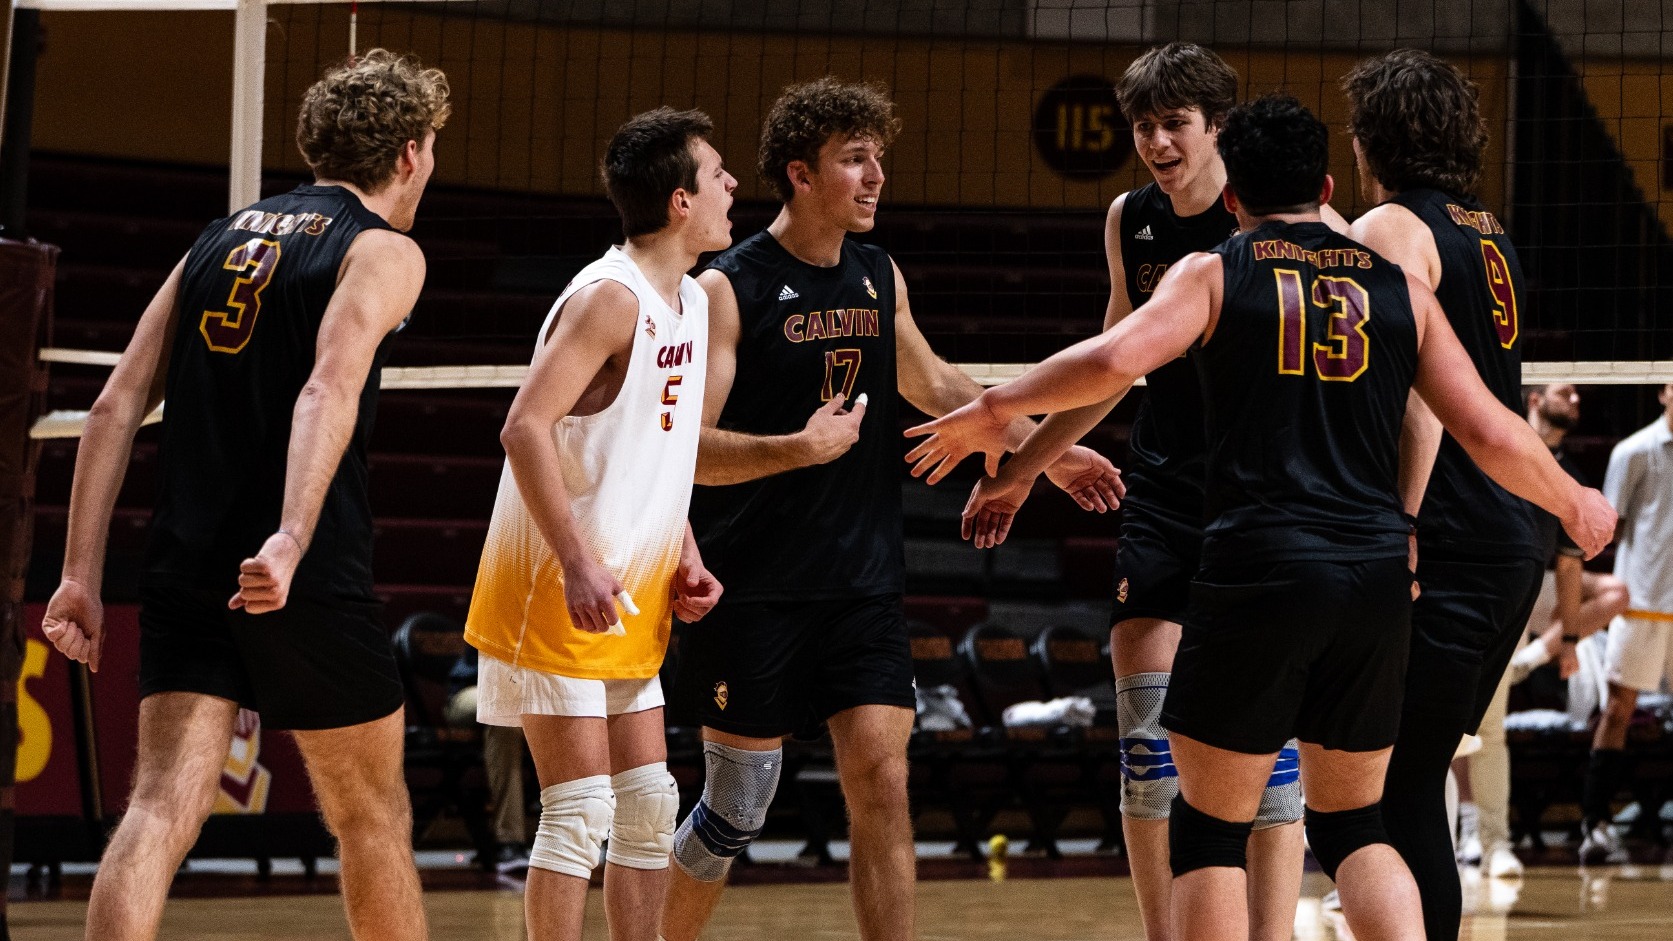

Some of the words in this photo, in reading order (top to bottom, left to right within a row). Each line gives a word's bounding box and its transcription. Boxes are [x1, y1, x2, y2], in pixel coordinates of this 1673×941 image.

[1056, 102, 1114, 152] 115
[1253, 239, 1373, 270] KNIGHTS
[199, 237, 282, 355] 3
[1480, 238, 1519, 350] 9
[783, 308, 880, 343] CALVIN
[1273, 267, 1371, 383] 13
[820, 348, 862, 402] 17
[660, 375, 683, 432] 5
